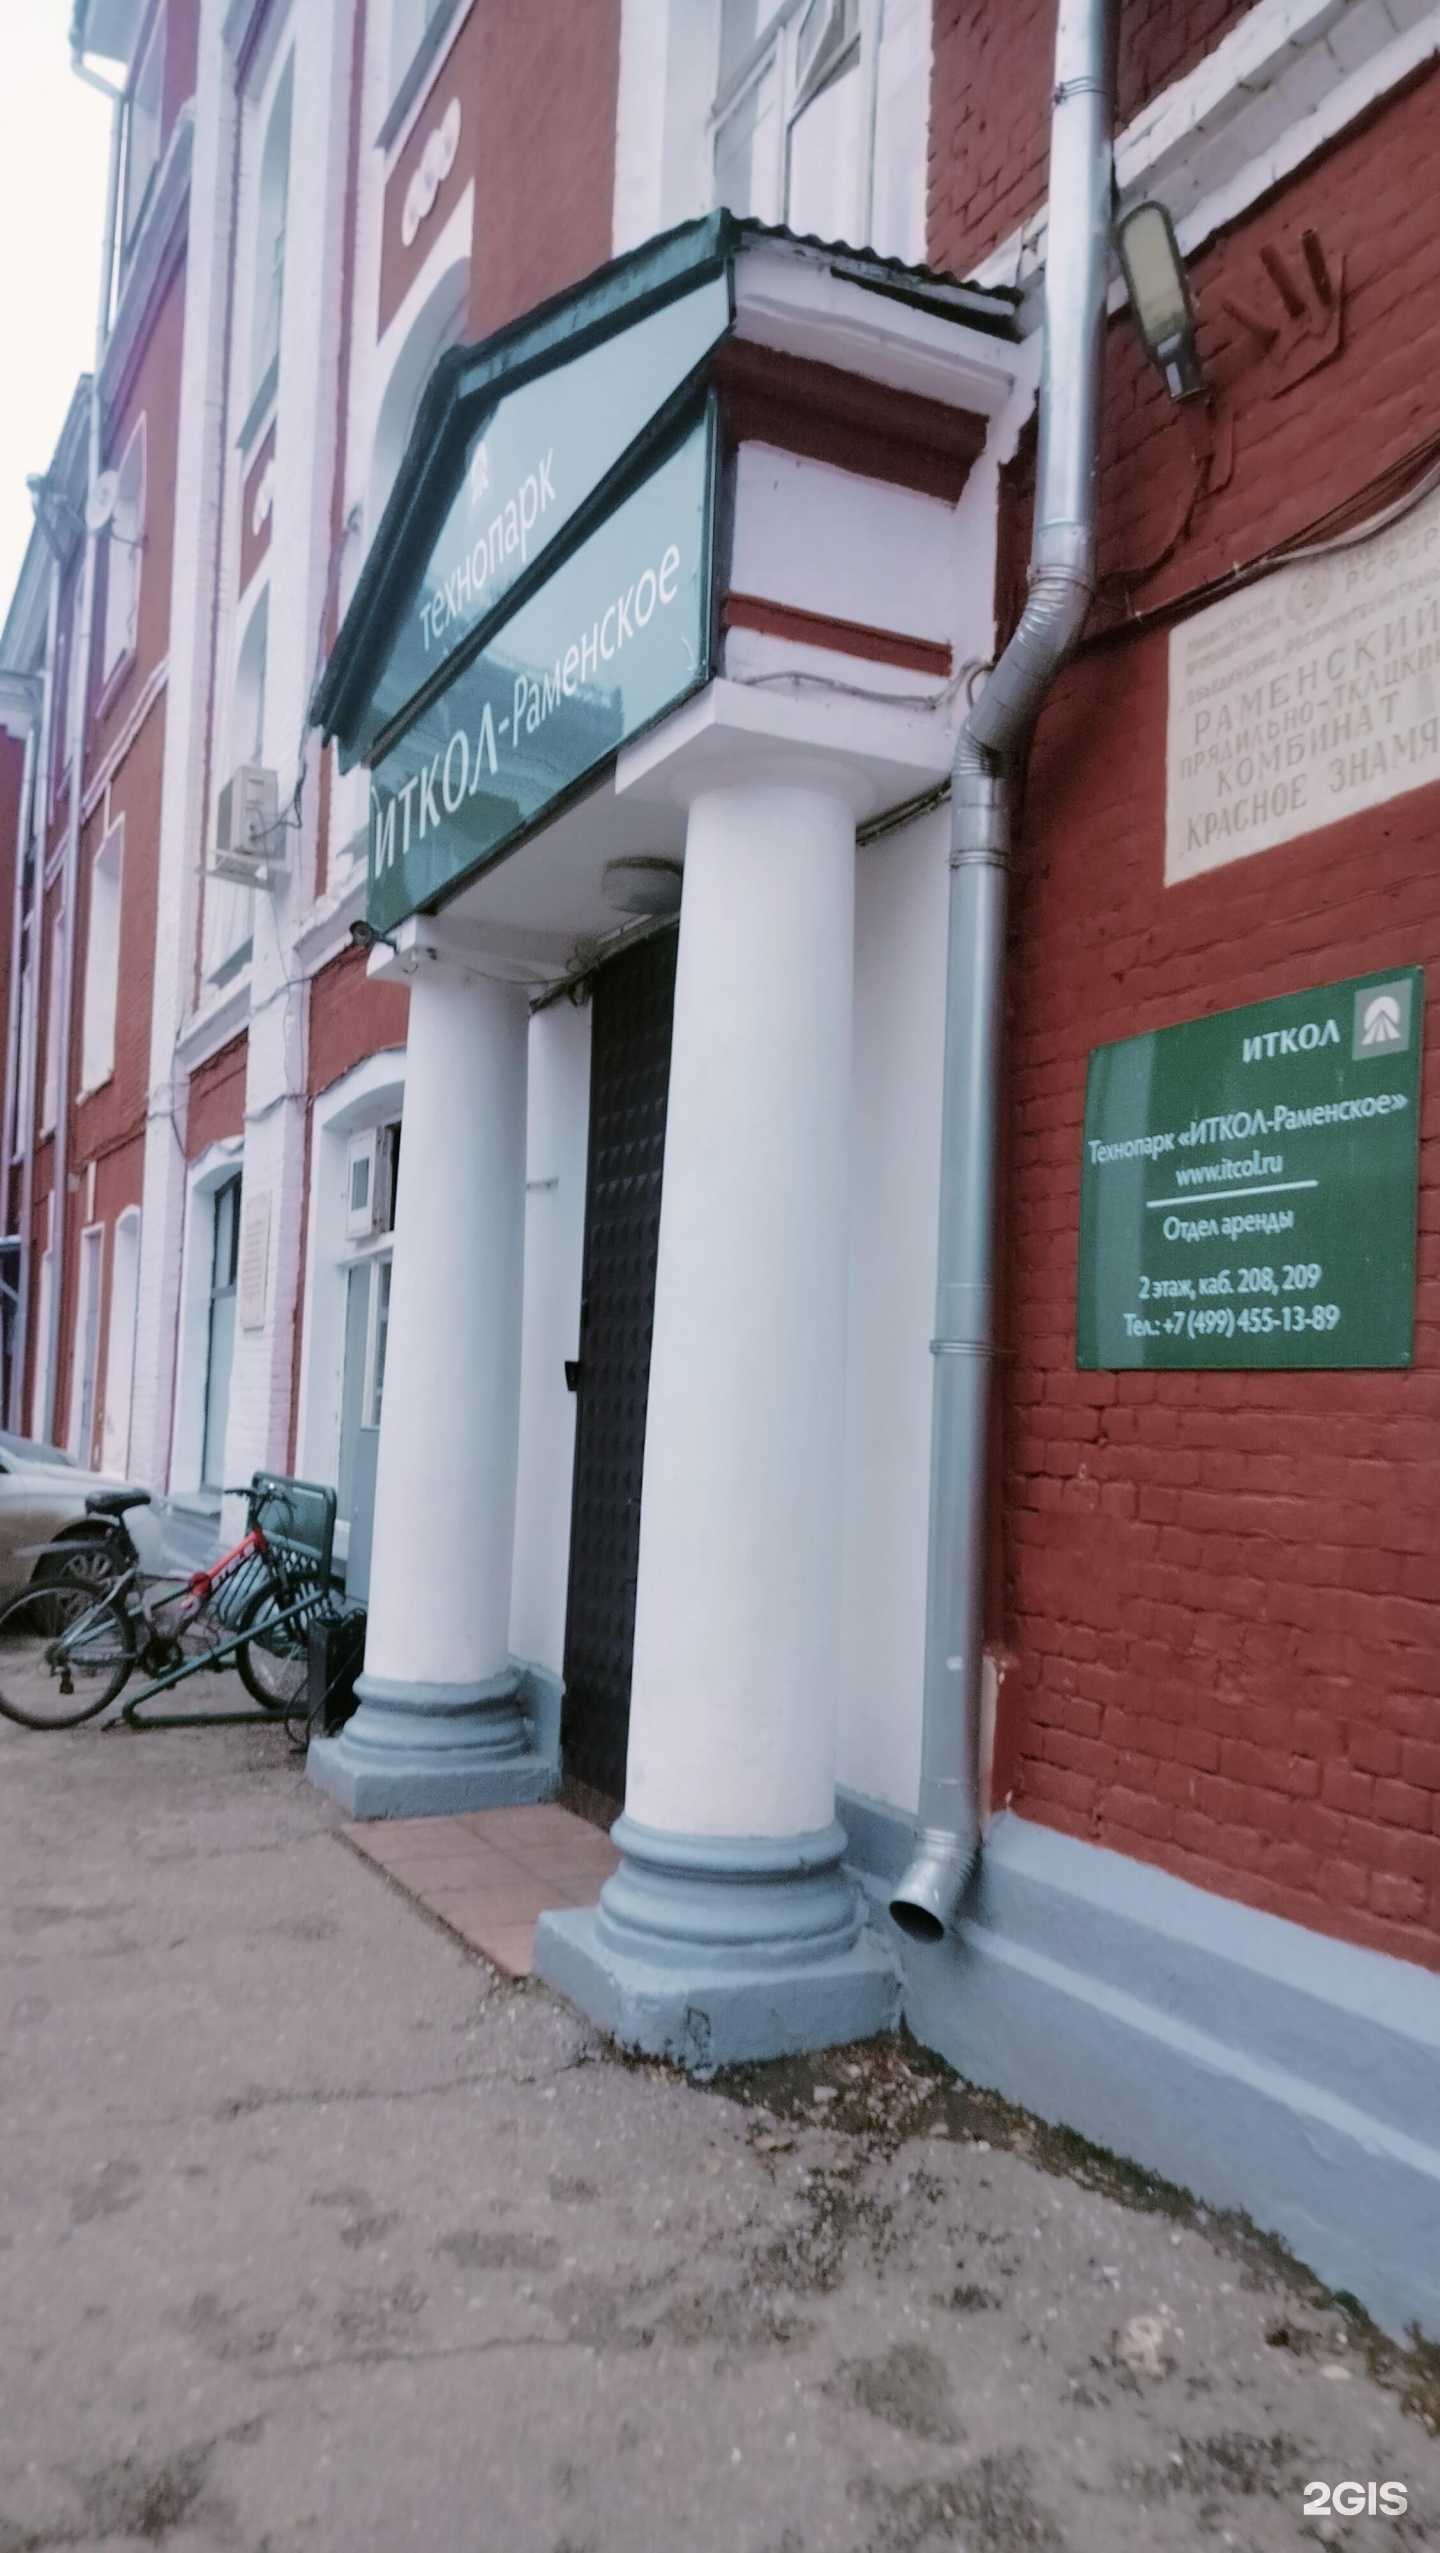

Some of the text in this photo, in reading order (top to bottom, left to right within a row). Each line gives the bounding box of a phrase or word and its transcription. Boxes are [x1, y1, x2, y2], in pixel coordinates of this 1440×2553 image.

[420, 449, 555, 652] технопарк
[1194, 594, 1440, 746] РАМЕНСКИЙ
[373, 544, 681, 878] ИТКОЛ-Раменское
[1216, 690, 1400, 797] КОМБИНАТ
[1328, 717, 1440, 794] ЗНАМЯ
[1241, 1019, 1340, 1063] ИТКОЛ
[1088, 1093, 1408, 1164] Технопарк «ИТКОЛ-Раменское»
[1175, 1150, 1284, 1187] www.itcol.ru
[1163, 1209, 1294, 1243] Отдел аренды
[1138, 1263, 1323, 1300] 2 этаж, каб. 208, 209
[1123, 1303, 1342, 1339] Тел.: +7 (499) 455-13-89
